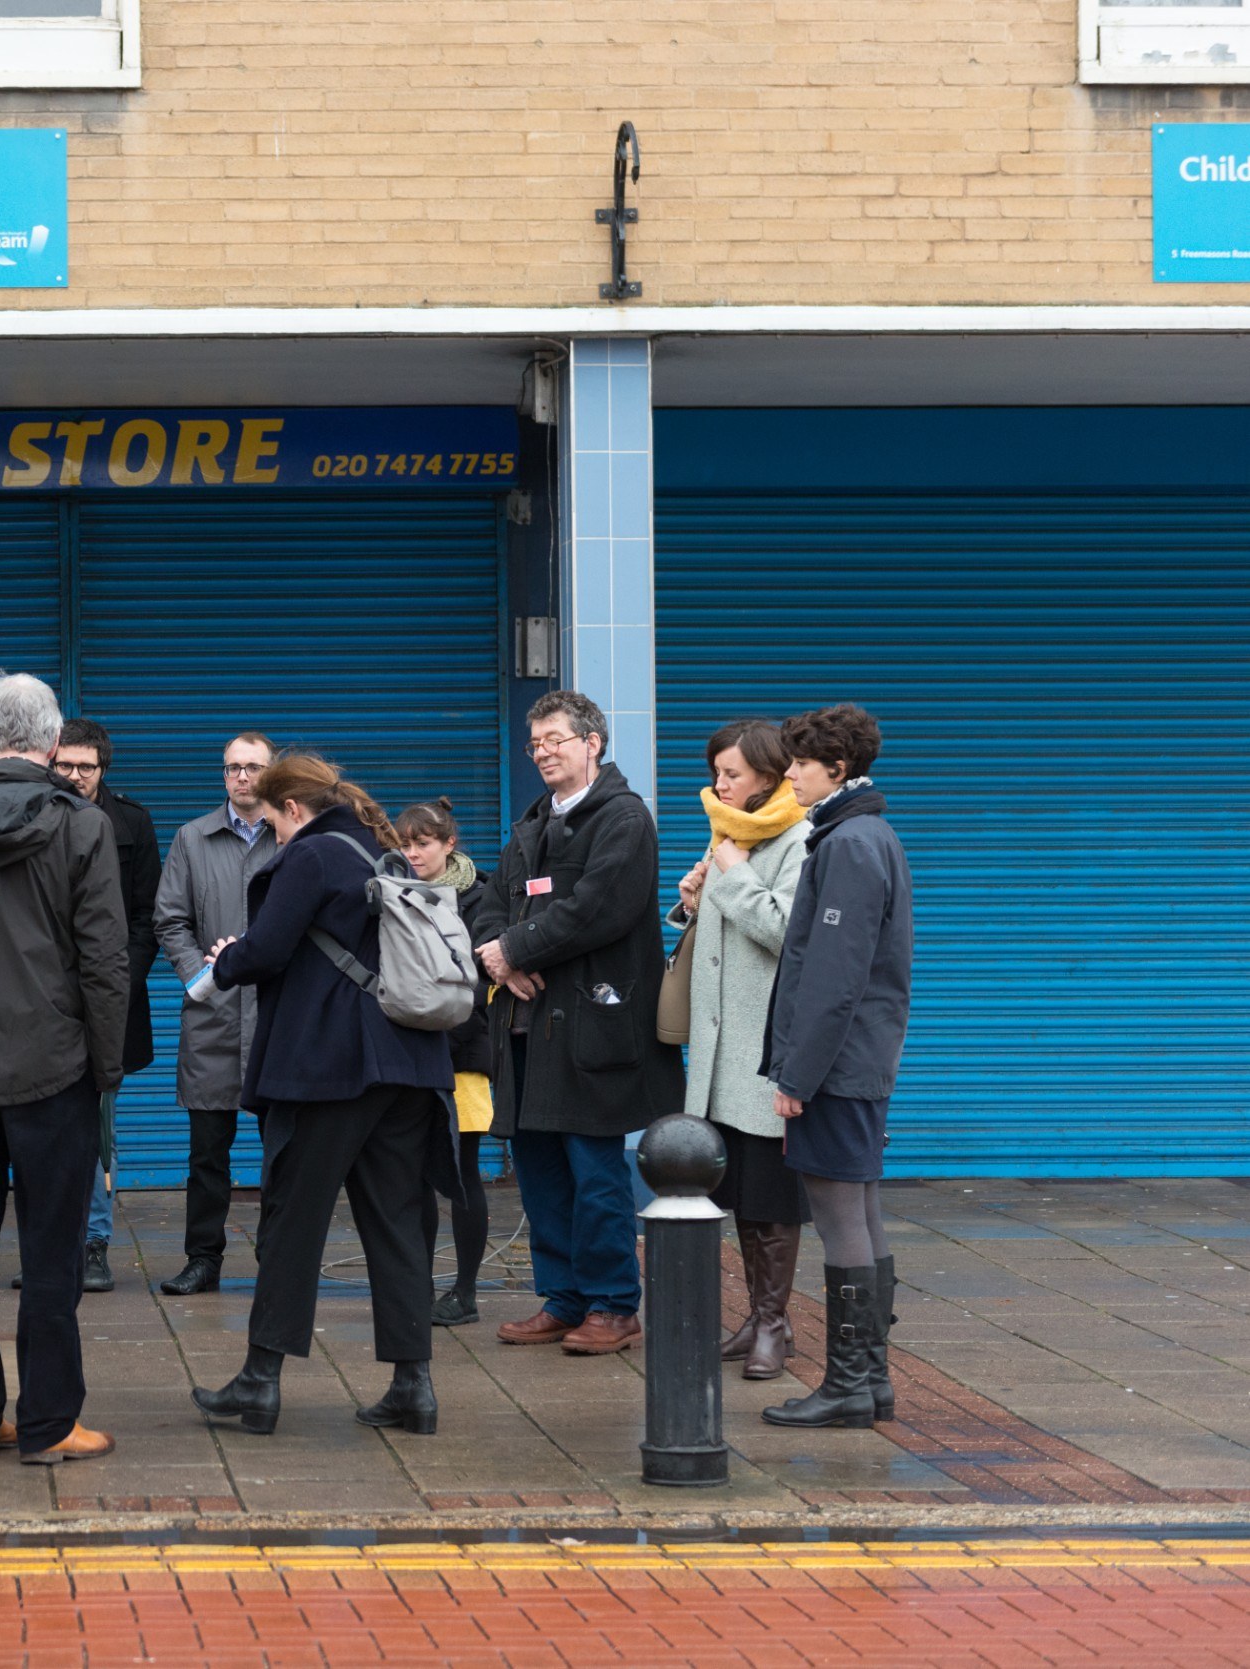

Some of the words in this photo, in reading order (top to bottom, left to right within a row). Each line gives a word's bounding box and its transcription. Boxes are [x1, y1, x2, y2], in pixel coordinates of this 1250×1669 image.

[2, 418, 285, 487] STORE
[312, 454, 369, 478] 020
[374, 453, 443, 476] 7474
[448, 453, 515, 475] 7755
